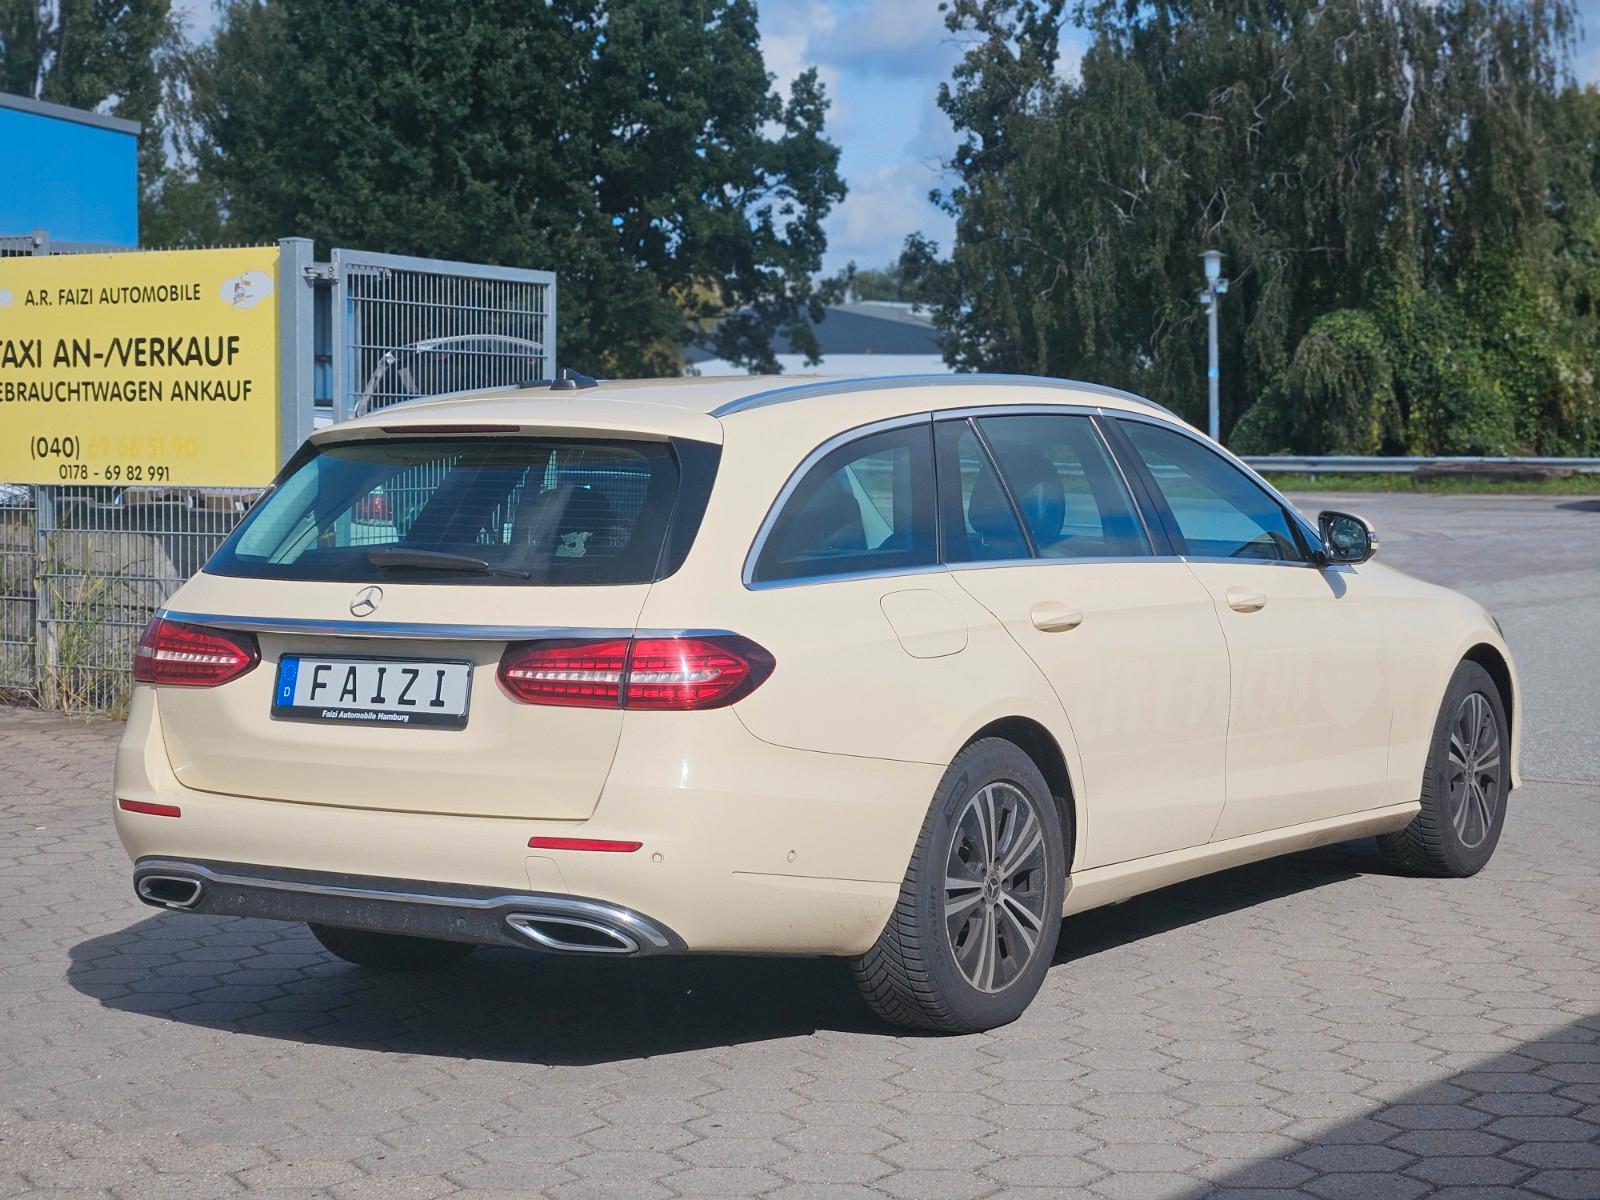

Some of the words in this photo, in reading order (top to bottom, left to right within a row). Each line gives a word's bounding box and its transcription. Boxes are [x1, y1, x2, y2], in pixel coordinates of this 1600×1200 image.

[25, 289, 52, 306] A.R.
[58, 288, 93, 305] FAIZI
[99, 284, 201, 305] AUTOMOBILE
[53, 335, 240, 368] AN-/VERKAUF
[170, 380, 252, 401] ANKAUF
[31, 435, 80, 460] (040)
[59, 464, 88, 480] 0178
[104, 465, 121, 481] 69
[126, 465, 143, 481] 82
[147, 466, 170, 482] 991
[283, 686, 291, 698] D
[321, 709, 338, 719] Faizi
[338, 711, 377, 720] Automobile
[377, 712, 410, 723] Hamburg
